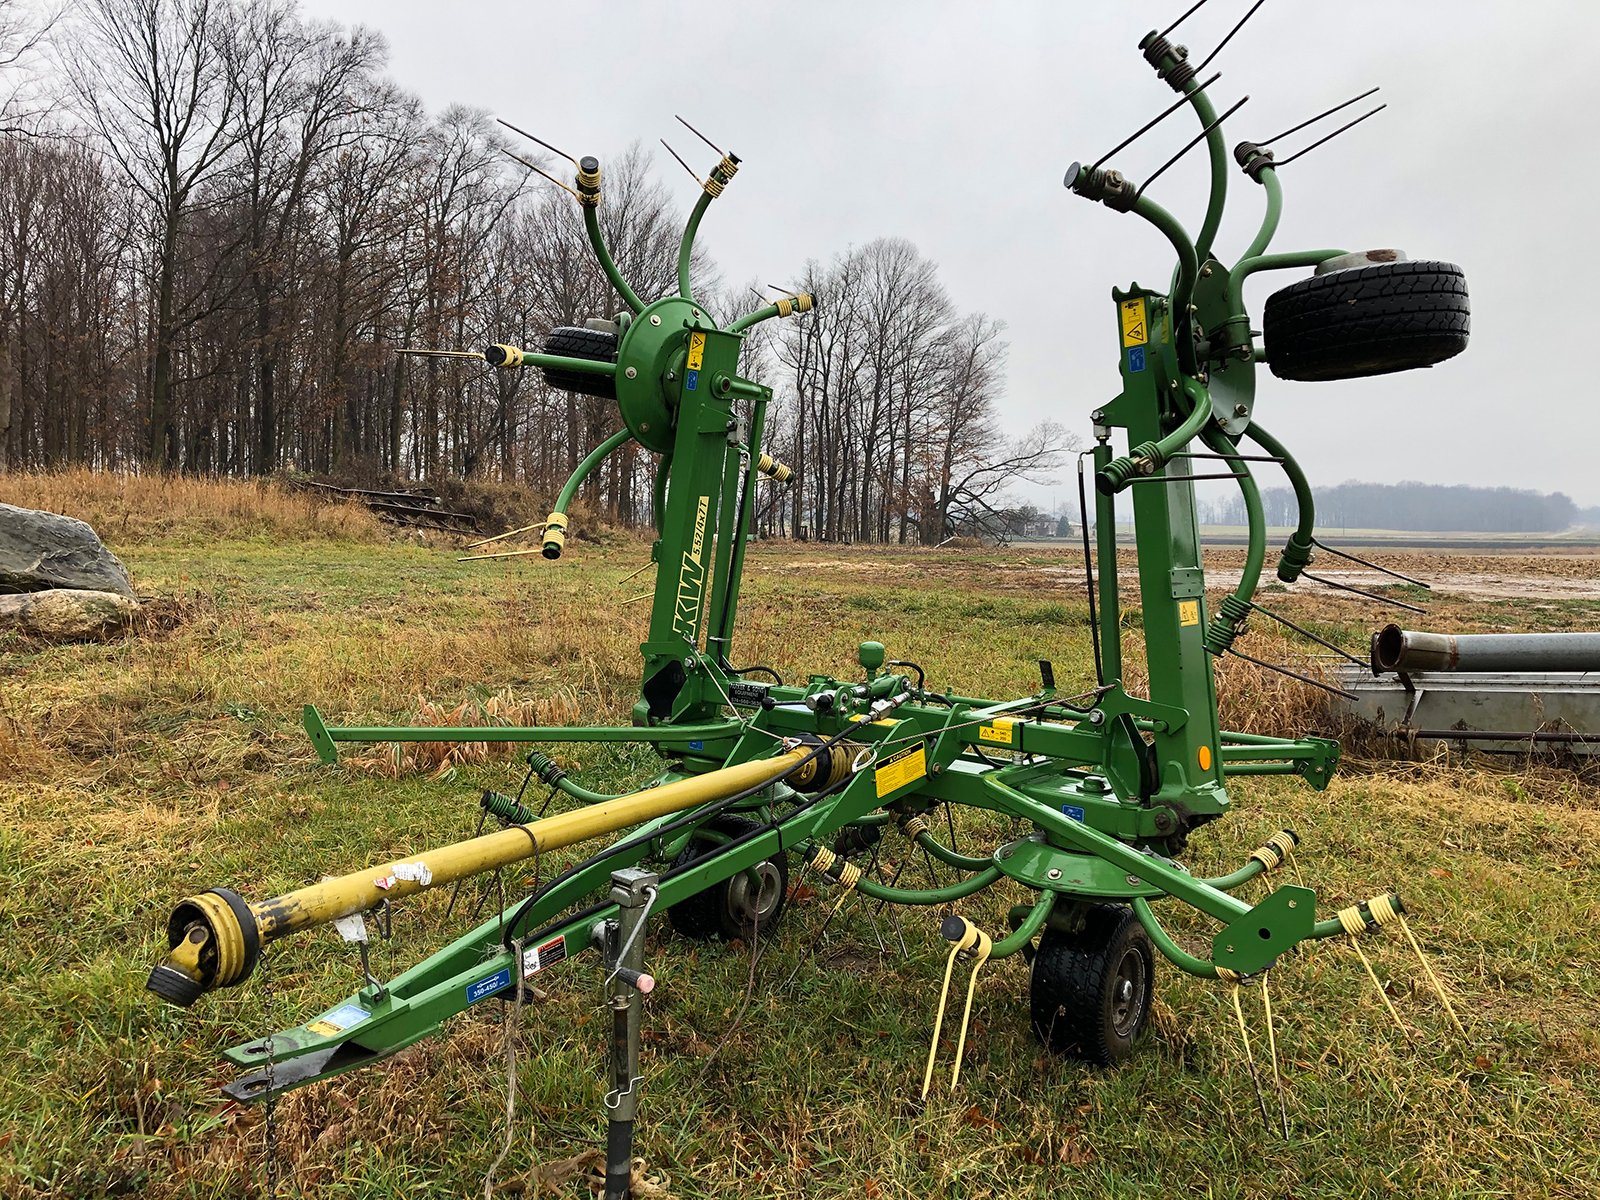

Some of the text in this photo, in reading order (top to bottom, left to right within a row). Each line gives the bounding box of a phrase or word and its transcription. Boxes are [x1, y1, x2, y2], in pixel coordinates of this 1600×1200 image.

[673, 500, 707, 639] KW 5.52/4x7T
[893, 749, 912, 761] CAUTION
